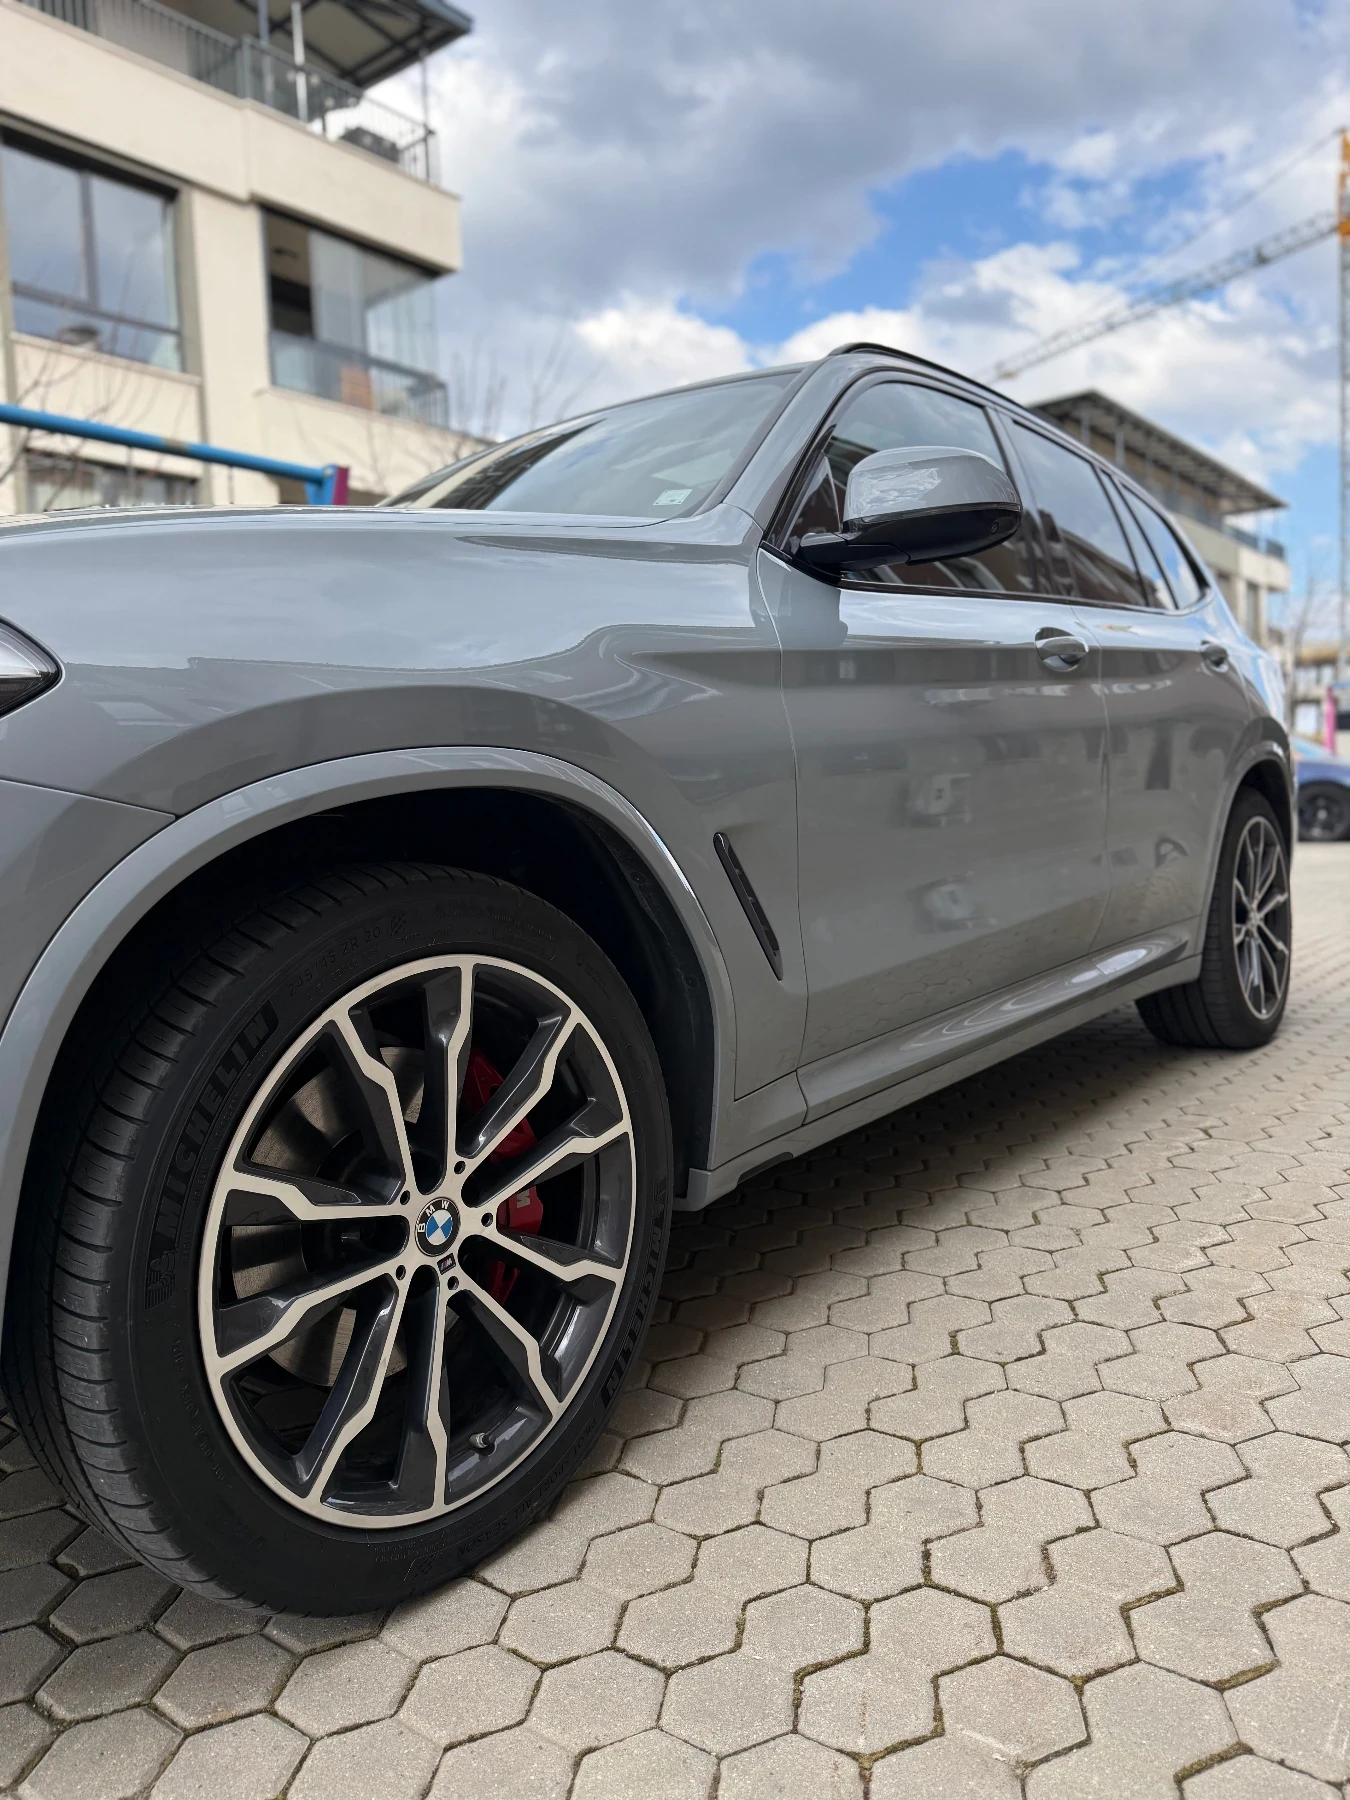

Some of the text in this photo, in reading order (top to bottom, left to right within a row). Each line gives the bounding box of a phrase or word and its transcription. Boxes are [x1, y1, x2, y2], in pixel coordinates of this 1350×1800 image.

[340, 935, 359, 956] ZR
[363, 925, 380, 943] 20
[154, 1006, 272, 1239] MICHELIN
[416, 1200, 450, 1232] BMW
[602, 1227, 661, 1402] MICHELIN
[570, 1418, 597, 1456] PILOT
[535, 1456, 570, 1499] SPORT
[512, 1496, 534, 1519] ALL
[456, 1518, 508, 1557] SEASON
